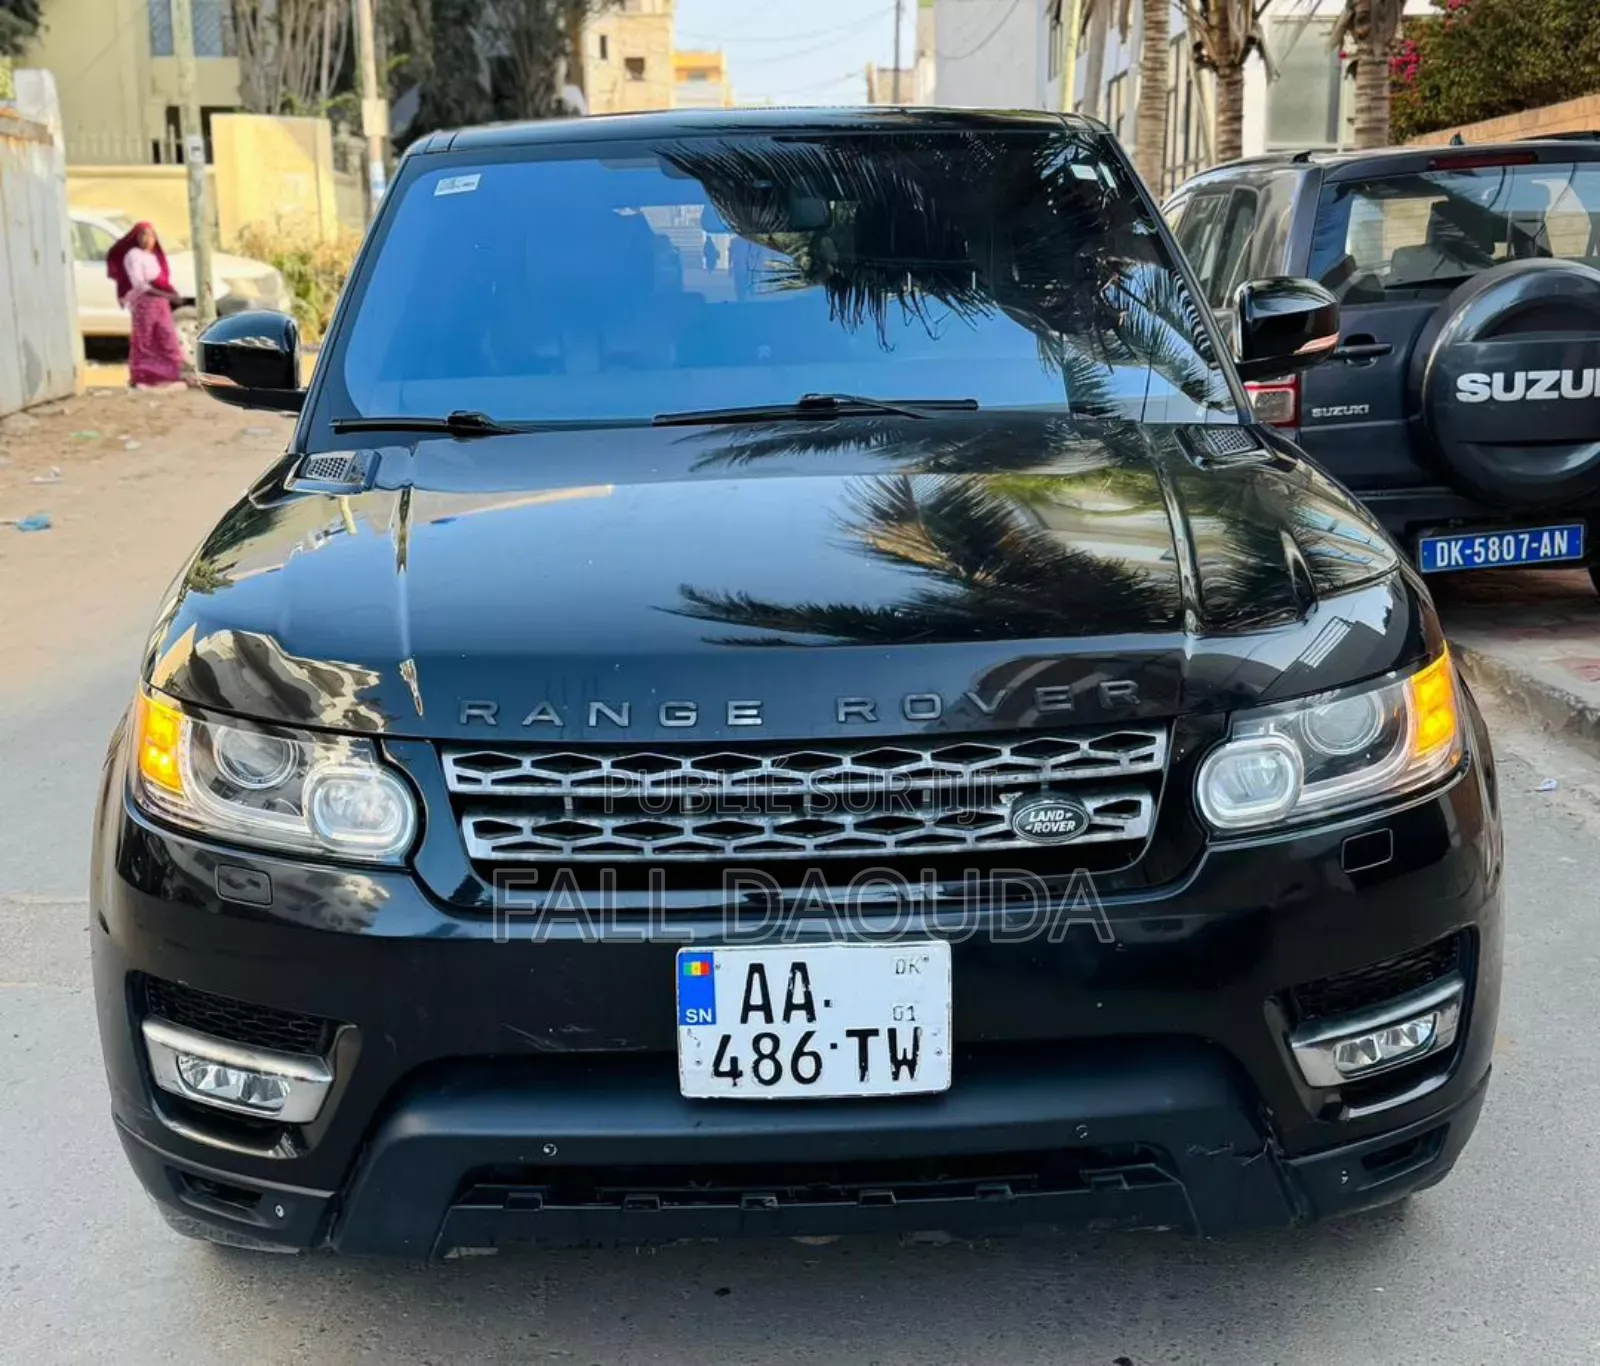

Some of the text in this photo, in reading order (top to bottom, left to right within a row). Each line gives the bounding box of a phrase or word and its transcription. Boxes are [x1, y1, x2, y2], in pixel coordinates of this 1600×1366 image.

[1456, 368, 1600, 403] SUZU
[1311, 404, 1370, 418] SUZUKI
[1435, 530, 1569, 568] DK-5807-AN
[459, 679, 1140, 727] RANGE ROVER
[1029, 809, 1065, 822] LAND
[1032, 820, 1076, 834] ROVER
[685, 1008, 713, 1023] SN
